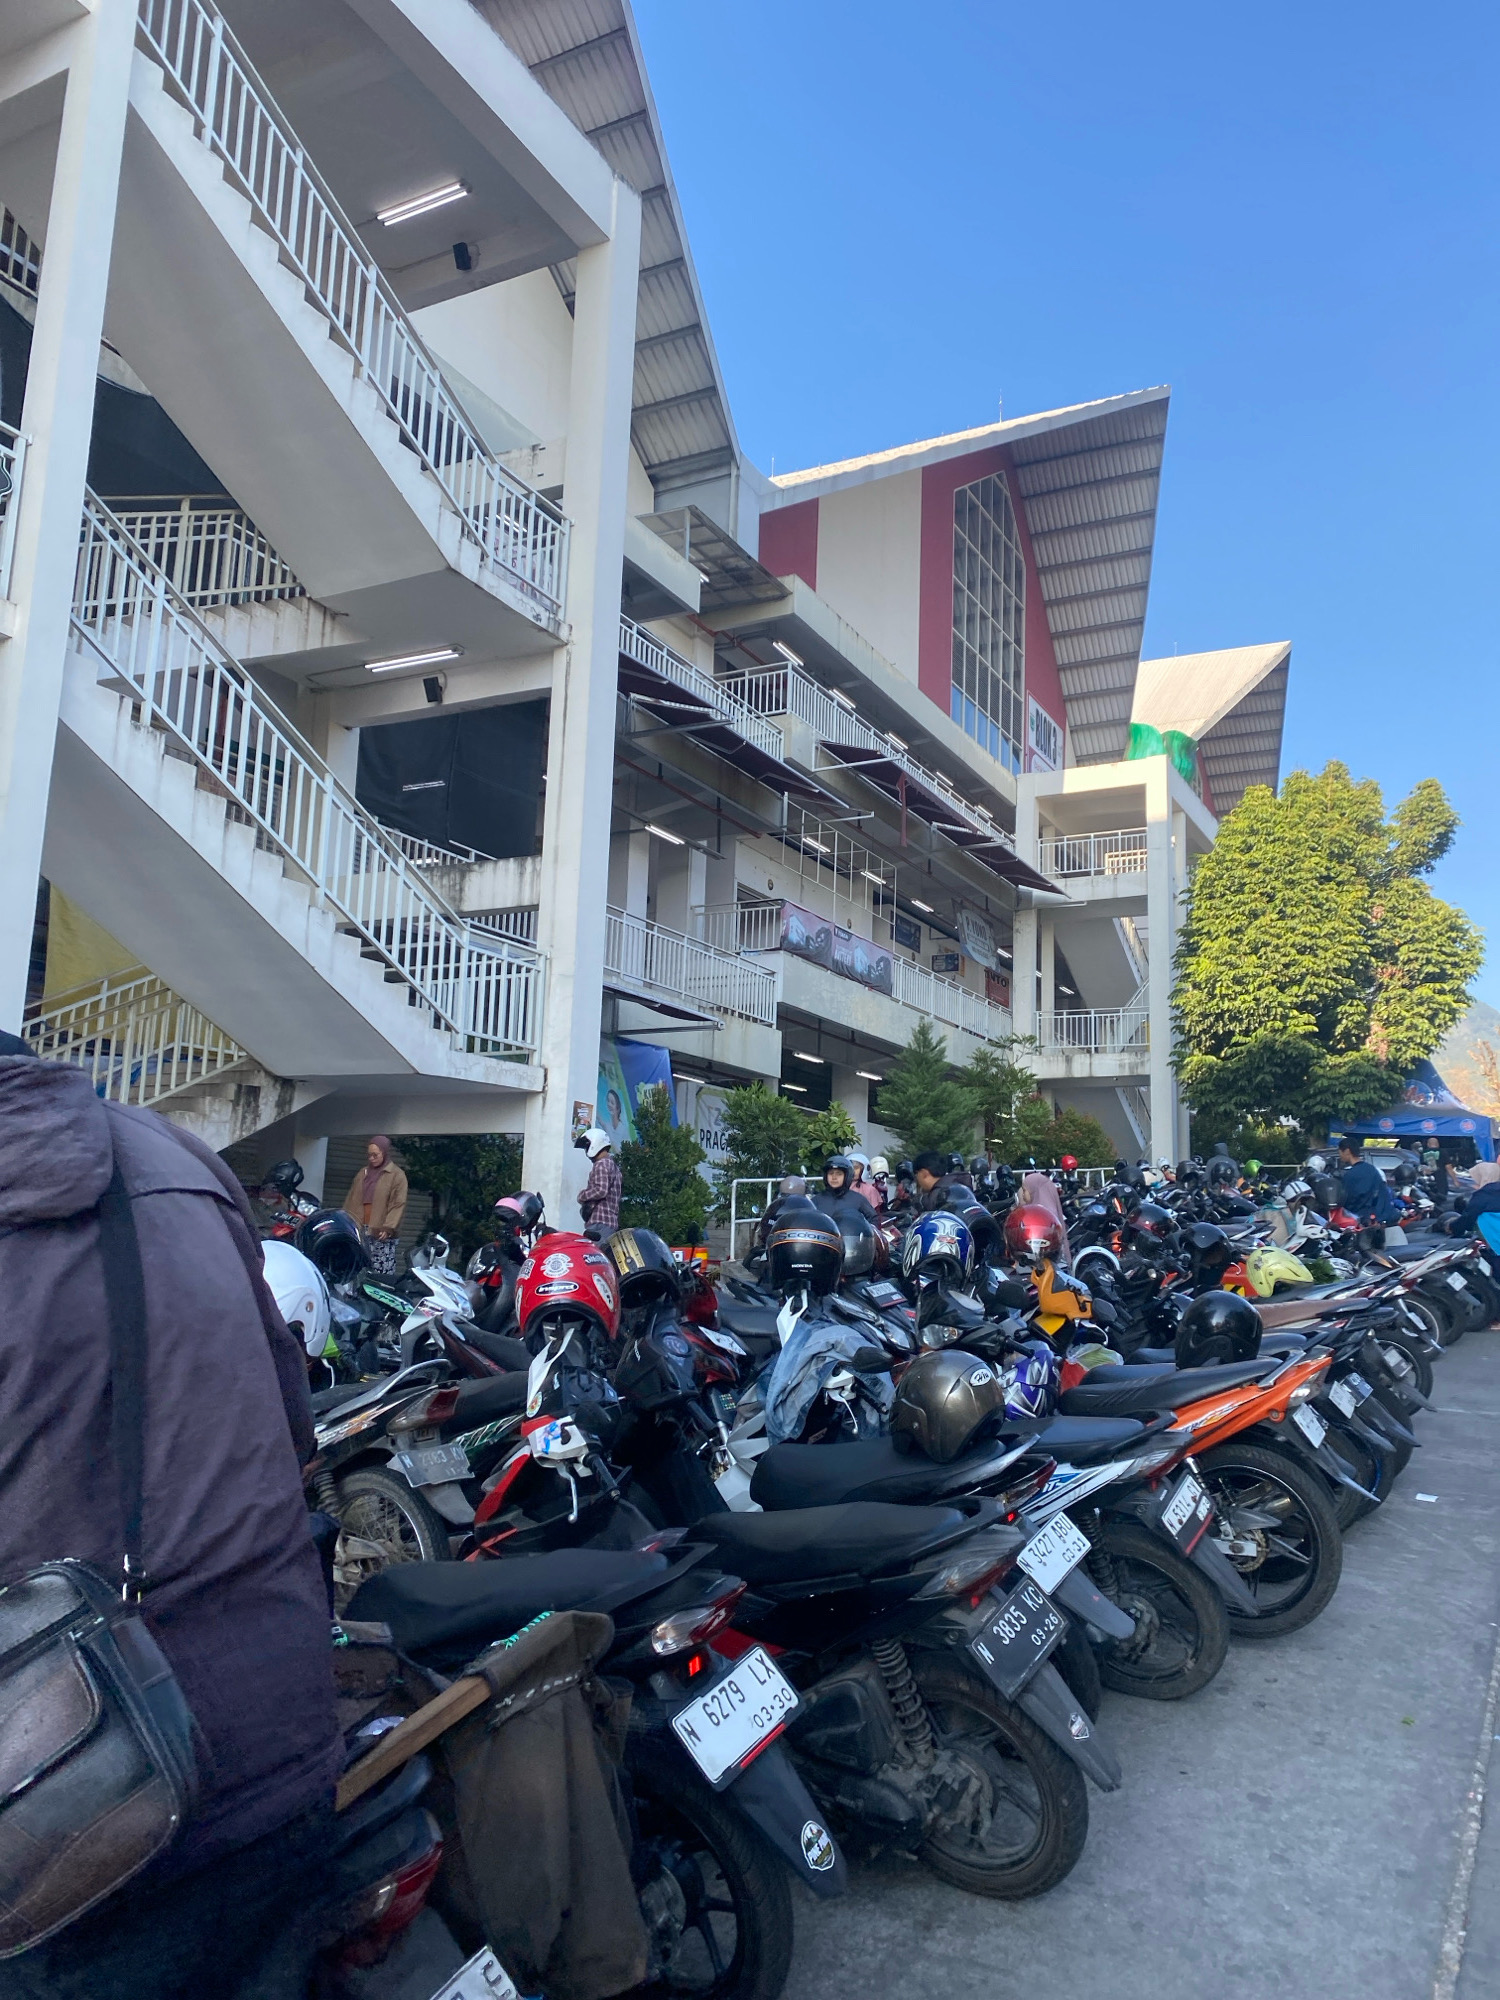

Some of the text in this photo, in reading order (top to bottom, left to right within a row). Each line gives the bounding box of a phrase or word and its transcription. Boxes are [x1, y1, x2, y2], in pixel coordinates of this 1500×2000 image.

[1035, 708, 1053, 760] BLOK
[1052, 726, 1058, 765] 3
[1018, 1556, 1035, 1574] N
[1028, 1532, 1056, 1565] 3427
[1050, 1514, 1074, 1540] ABU
[977, 1586, 1044, 1665] N 3835 KC
[680, 1654, 776, 1748] N 6279 LX
